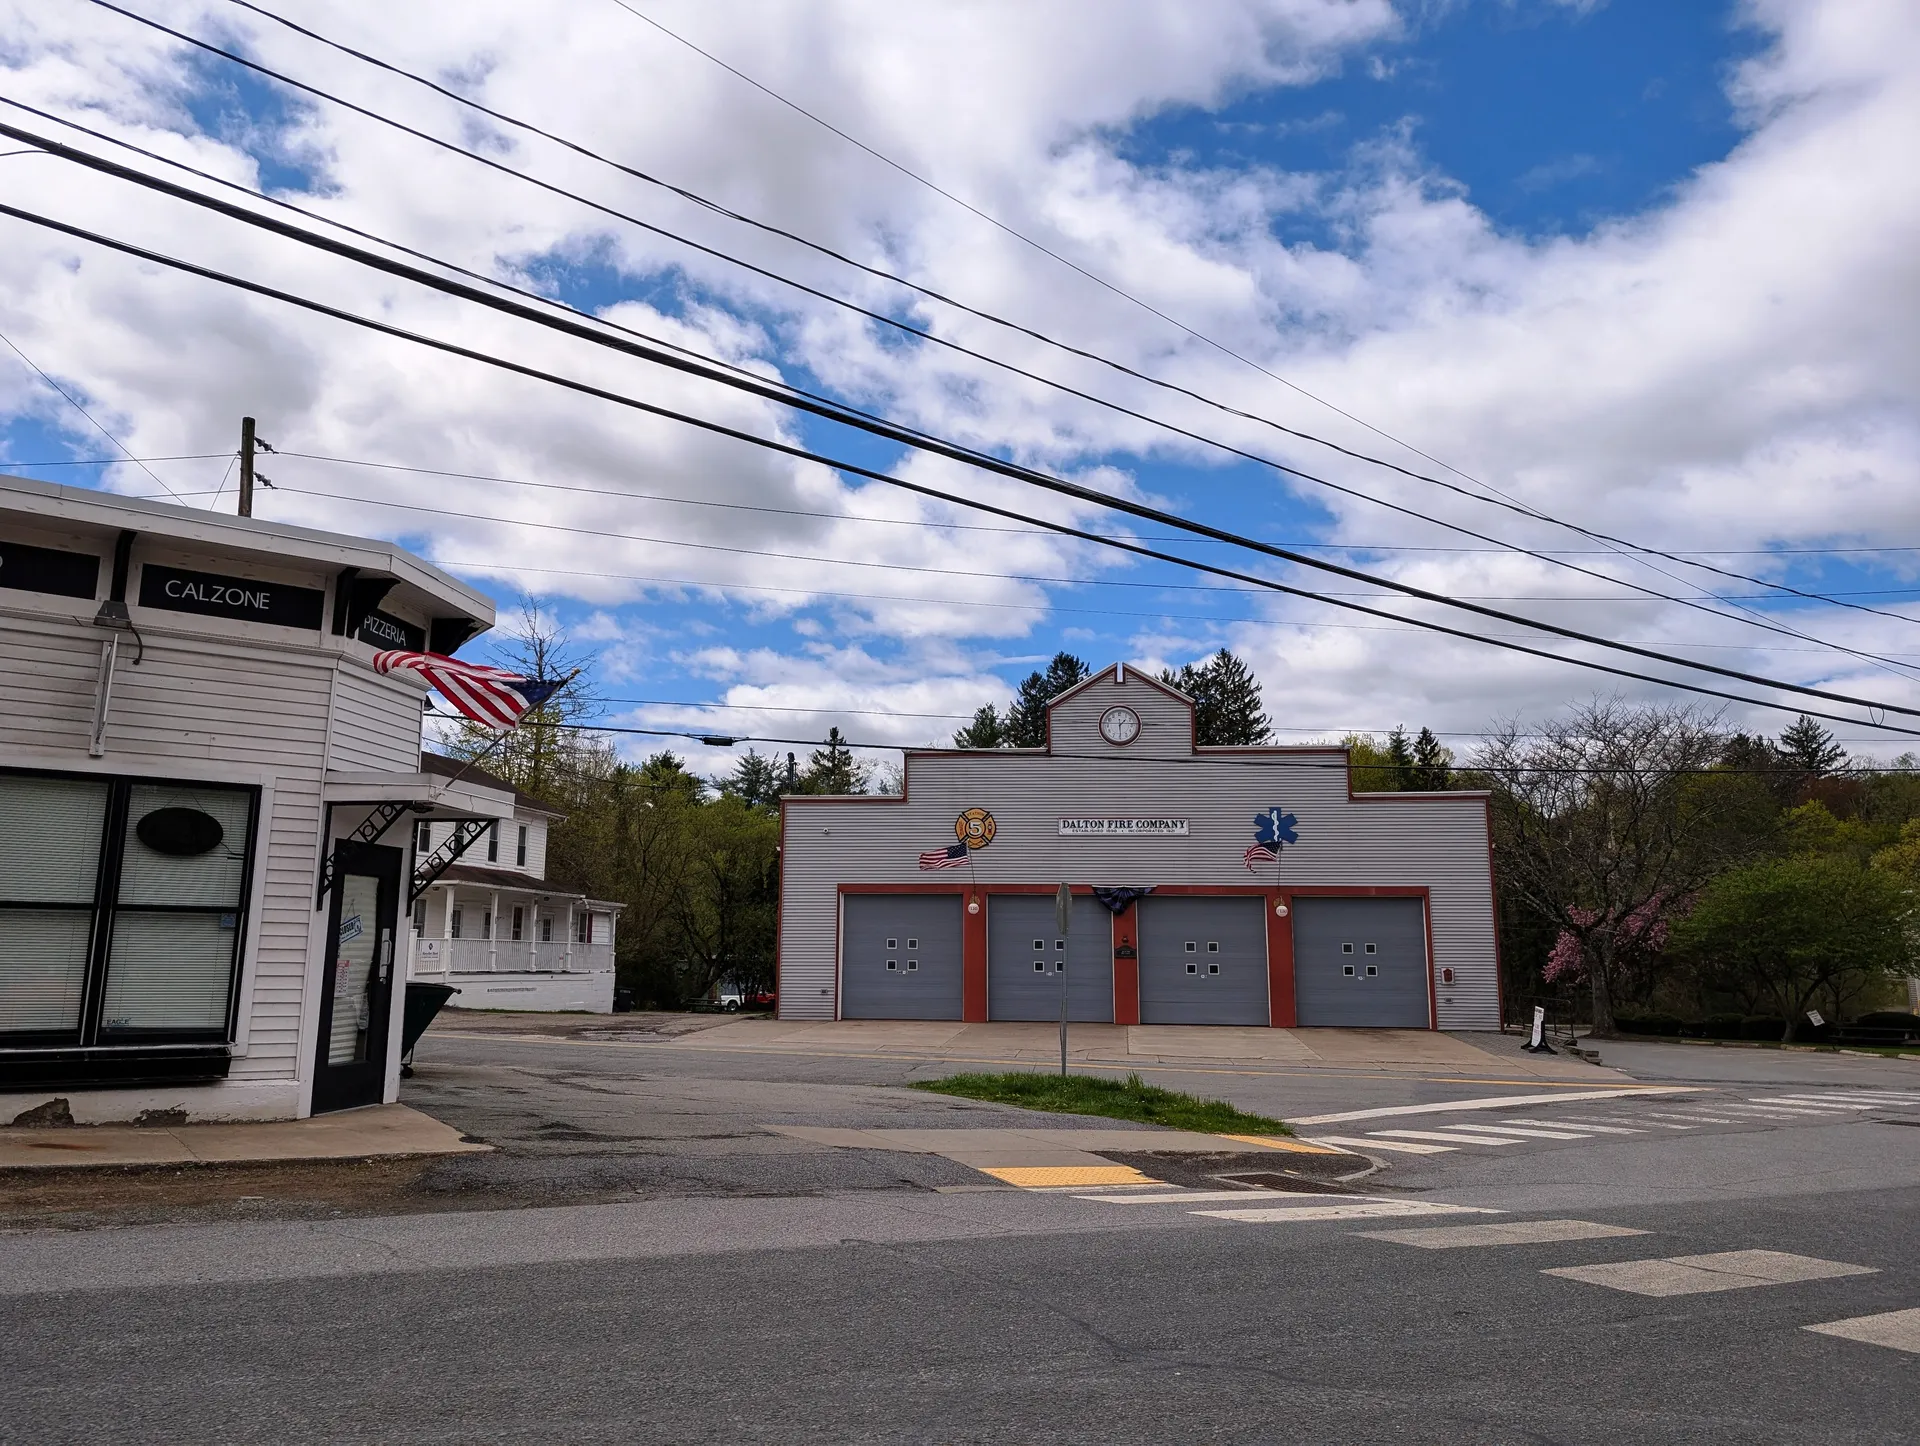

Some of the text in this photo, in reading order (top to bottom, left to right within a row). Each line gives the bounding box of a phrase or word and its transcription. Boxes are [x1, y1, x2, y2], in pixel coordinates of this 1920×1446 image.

[165, 580, 271, 609] CALZONE
[363, 614, 406, 646] PIZZERIA
[968, 821, 982, 836] 5
[1062, 820, 1186, 829] DALTON FIRE COMPANY
